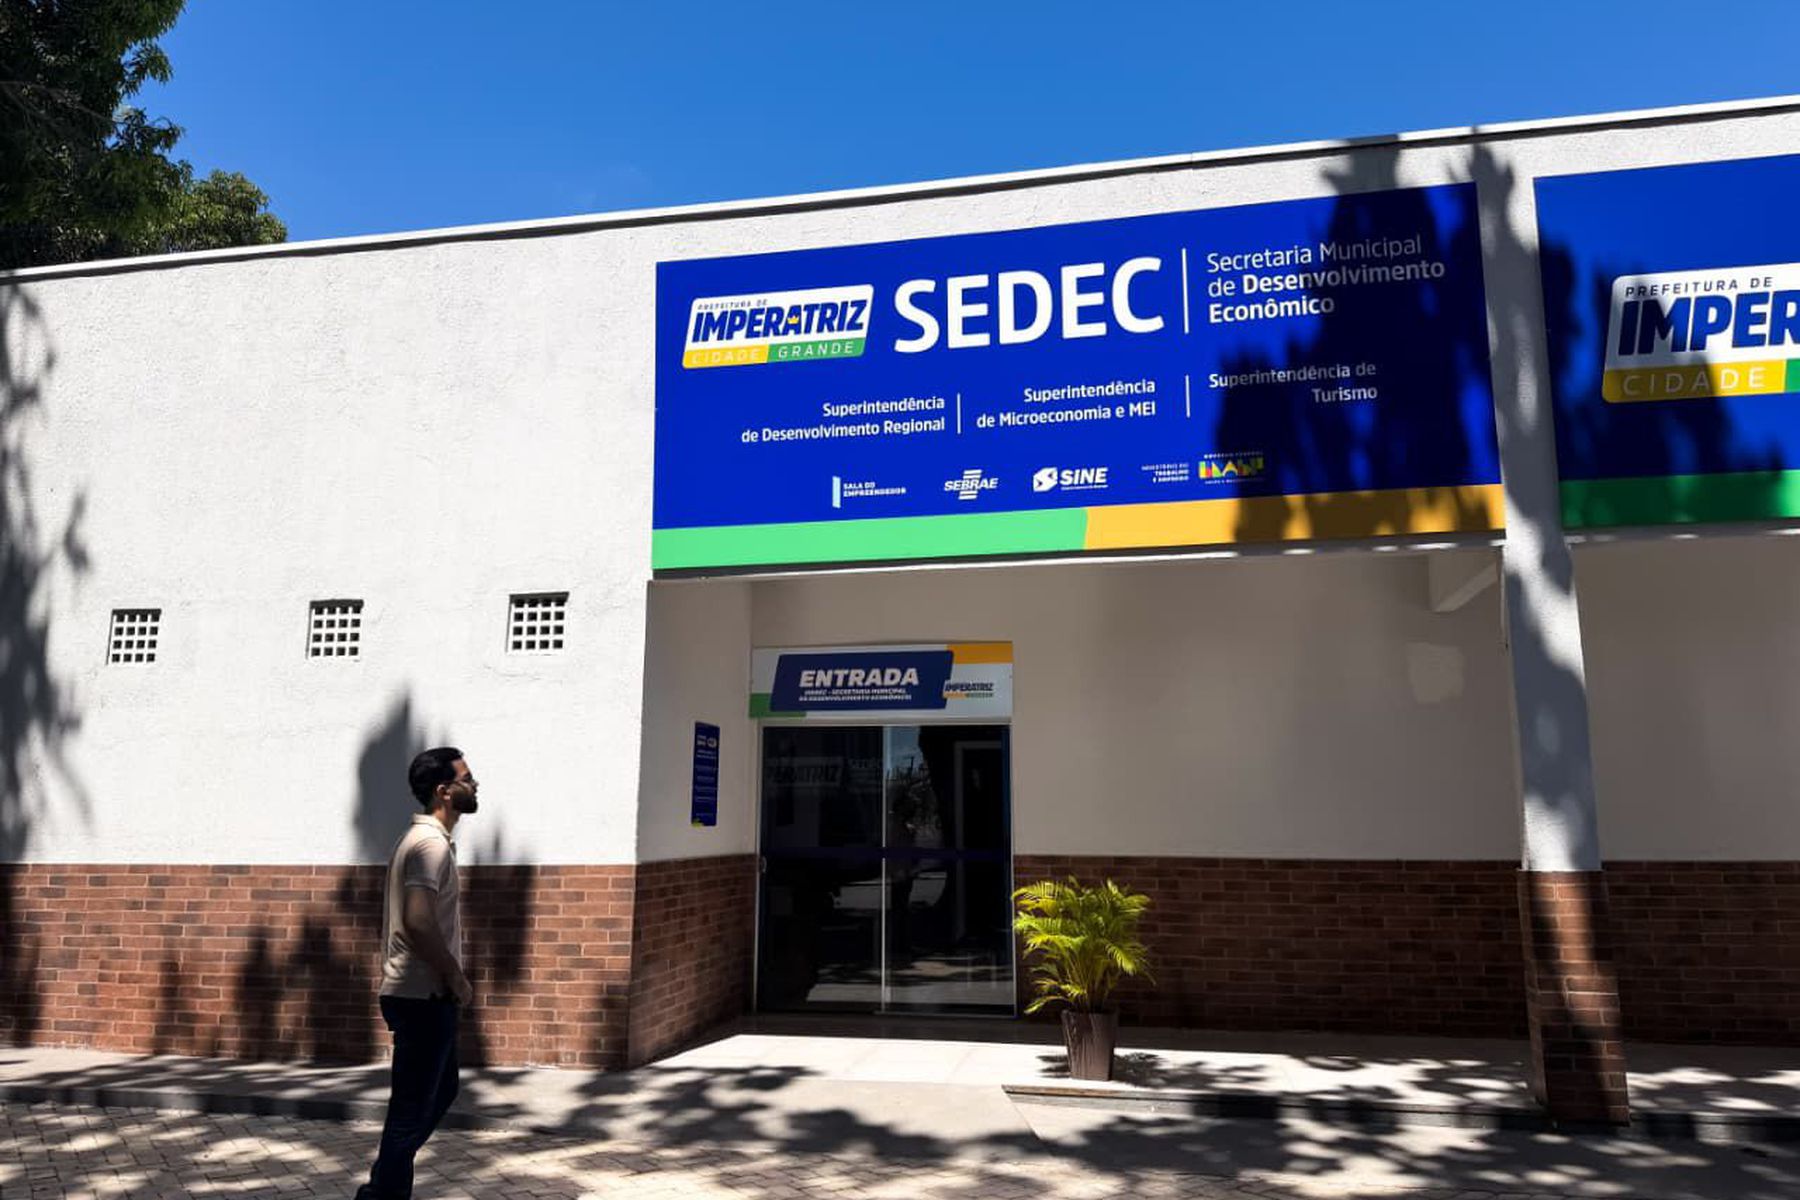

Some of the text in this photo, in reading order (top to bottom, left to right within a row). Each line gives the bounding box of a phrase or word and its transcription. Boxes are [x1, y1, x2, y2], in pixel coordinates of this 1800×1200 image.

[1207, 234, 1422, 273] Secretaria Municipal
[1208, 259, 1446, 298] de Desenvolvimento
[1625, 276, 1773, 298] PREFEITURA DE
[894, 256, 1165, 353] SEDEC
[1209, 294, 1335, 324] Econômico
[692, 299, 867, 343] IMPERATRIZ
[692, 341, 854, 364] CIDADE GRANDE
[1209, 362, 1376, 389] Superintendência de
[1622, 365, 1767, 396] CIDADE
[1024, 378, 1156, 404] Superintendência
[1312, 385, 1378, 404] Turismo
[822, 395, 945, 418] Superintendência
[976, 401, 1156, 428] de Microeconomia e MEI
[741, 417, 945, 444] de Desenvolvimento Regional
[944, 477, 998, 491] SEBRAE
[1060, 467, 1108, 485] SINE
[799, 668, 919, 687] ENTRADA
